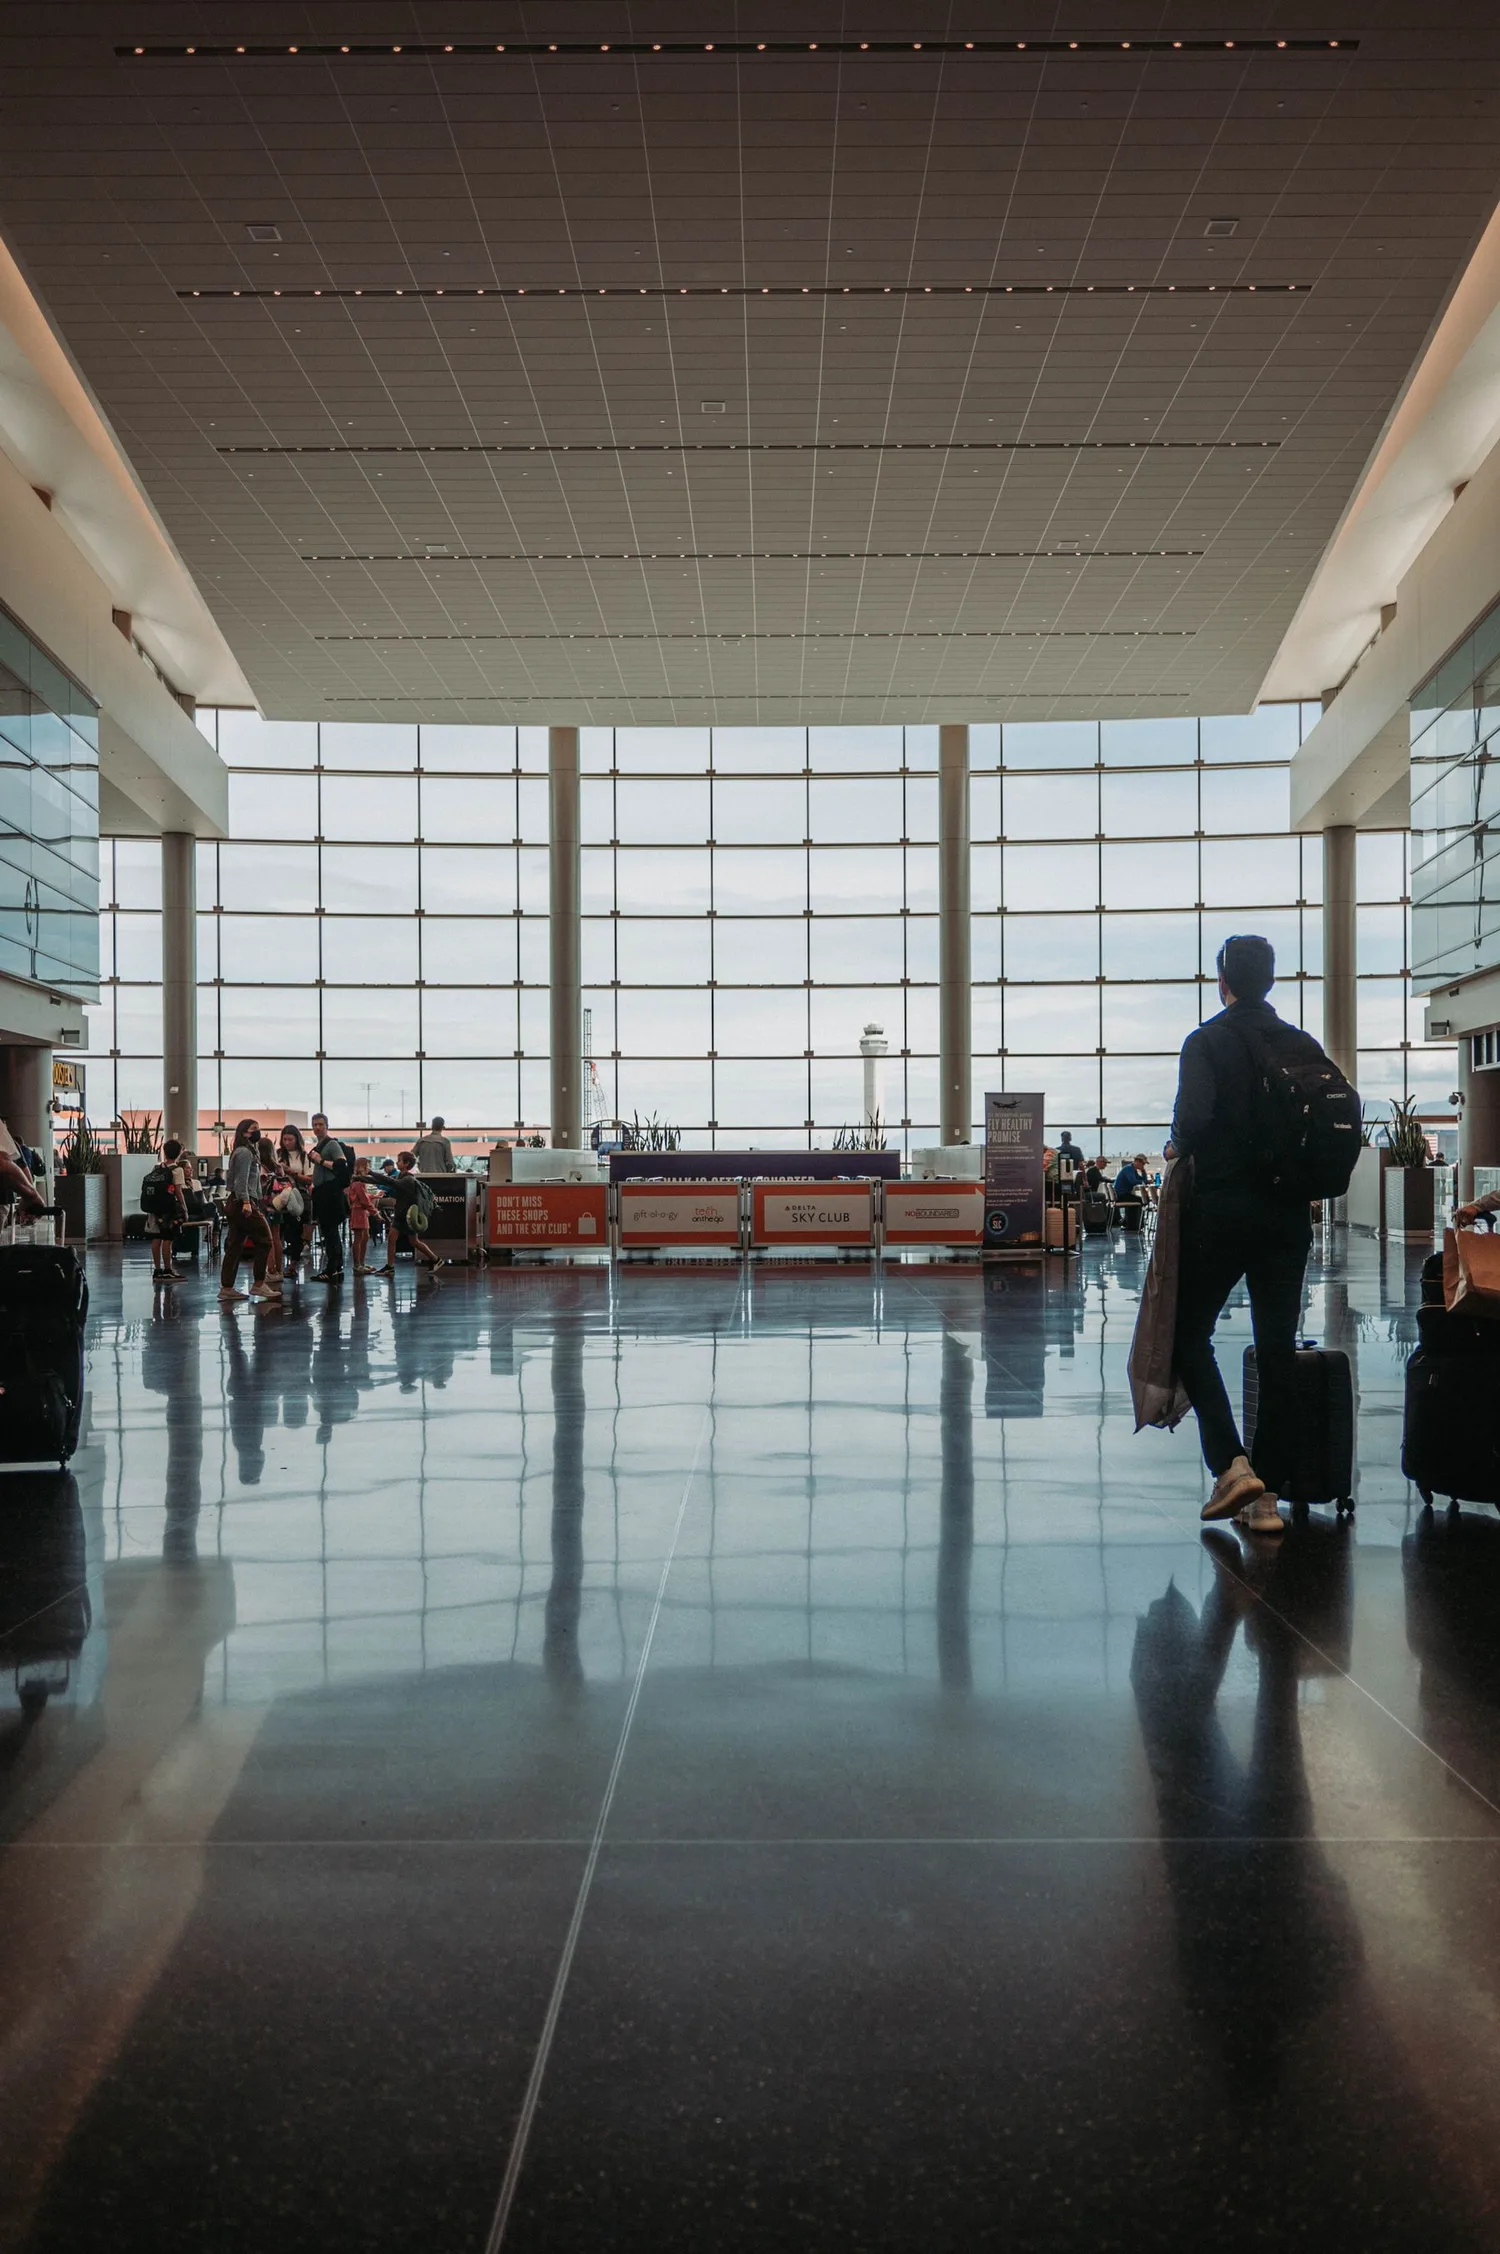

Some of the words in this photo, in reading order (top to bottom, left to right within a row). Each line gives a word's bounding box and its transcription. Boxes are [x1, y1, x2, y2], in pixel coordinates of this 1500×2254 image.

[987, 1118, 1000, 1130] FLY
[1001, 1118, 1033, 1130] HEALTHY
[987, 1130, 1021, 1143] PROMISE
[432, 1195, 465, 1203] RMATION
[496, 1195, 520, 1208] DON'T
[521, 1195, 543, 1208] MISS
[497, 1209, 521, 1221] THESE
[522, 1209, 549, 1221] SHOPS
[791, 1212, 816, 1223] SKY
[818, 1212, 850, 1223] CLUB
[496, 1223, 513, 1235] AND
[515, 1223, 529, 1235] THE
[531, 1223, 547, 1235] SKY
